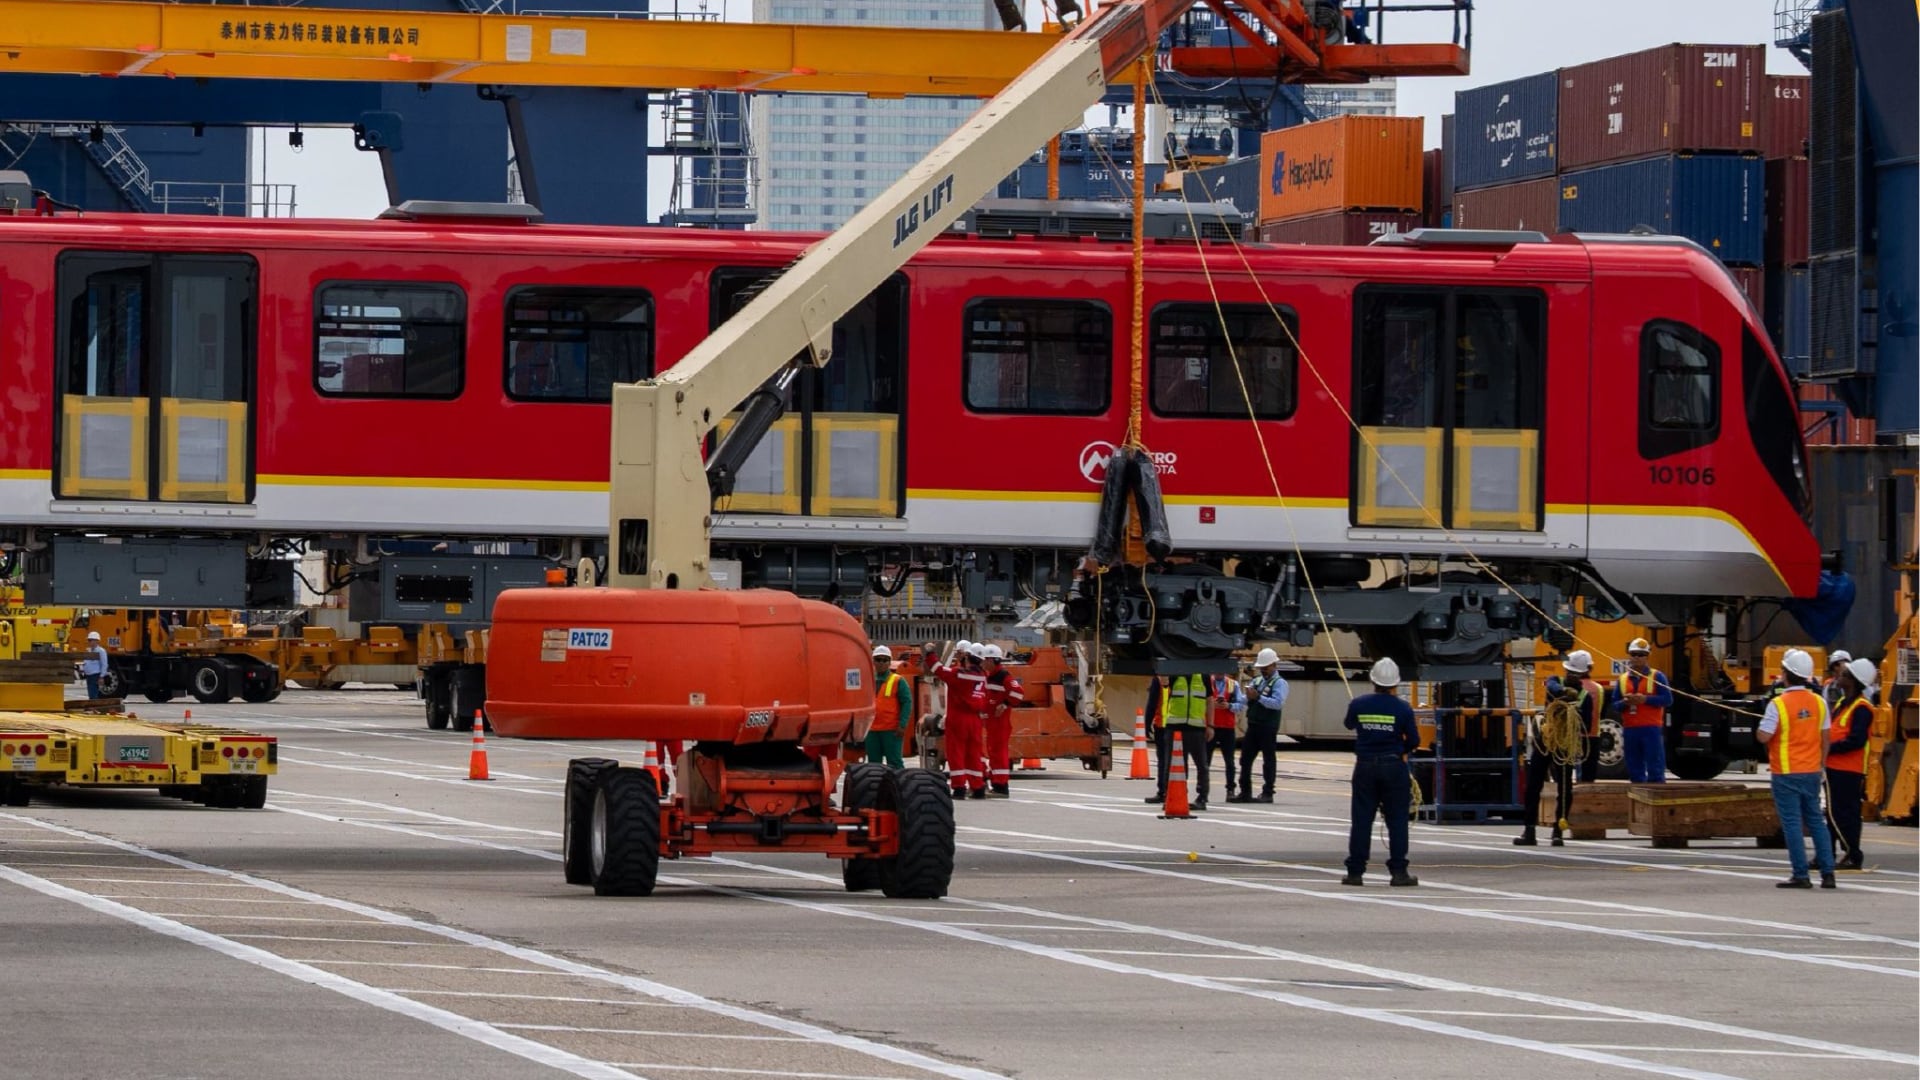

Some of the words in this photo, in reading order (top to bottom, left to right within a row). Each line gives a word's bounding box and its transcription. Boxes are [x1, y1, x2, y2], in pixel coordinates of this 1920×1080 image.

[221, 21, 420, 46] 泰州市索力特吊装设备有限公司
[1703, 52, 1737, 67] ZIM
[1774, 85, 1801, 98] tex
[893, 202, 919, 249] JLG
[923, 173, 954, 223] LIFT
[1370, 222, 1398, 234] ZIM
[1648, 465, 1716, 486] 10106
[571, 631, 609, 647] PAT02
